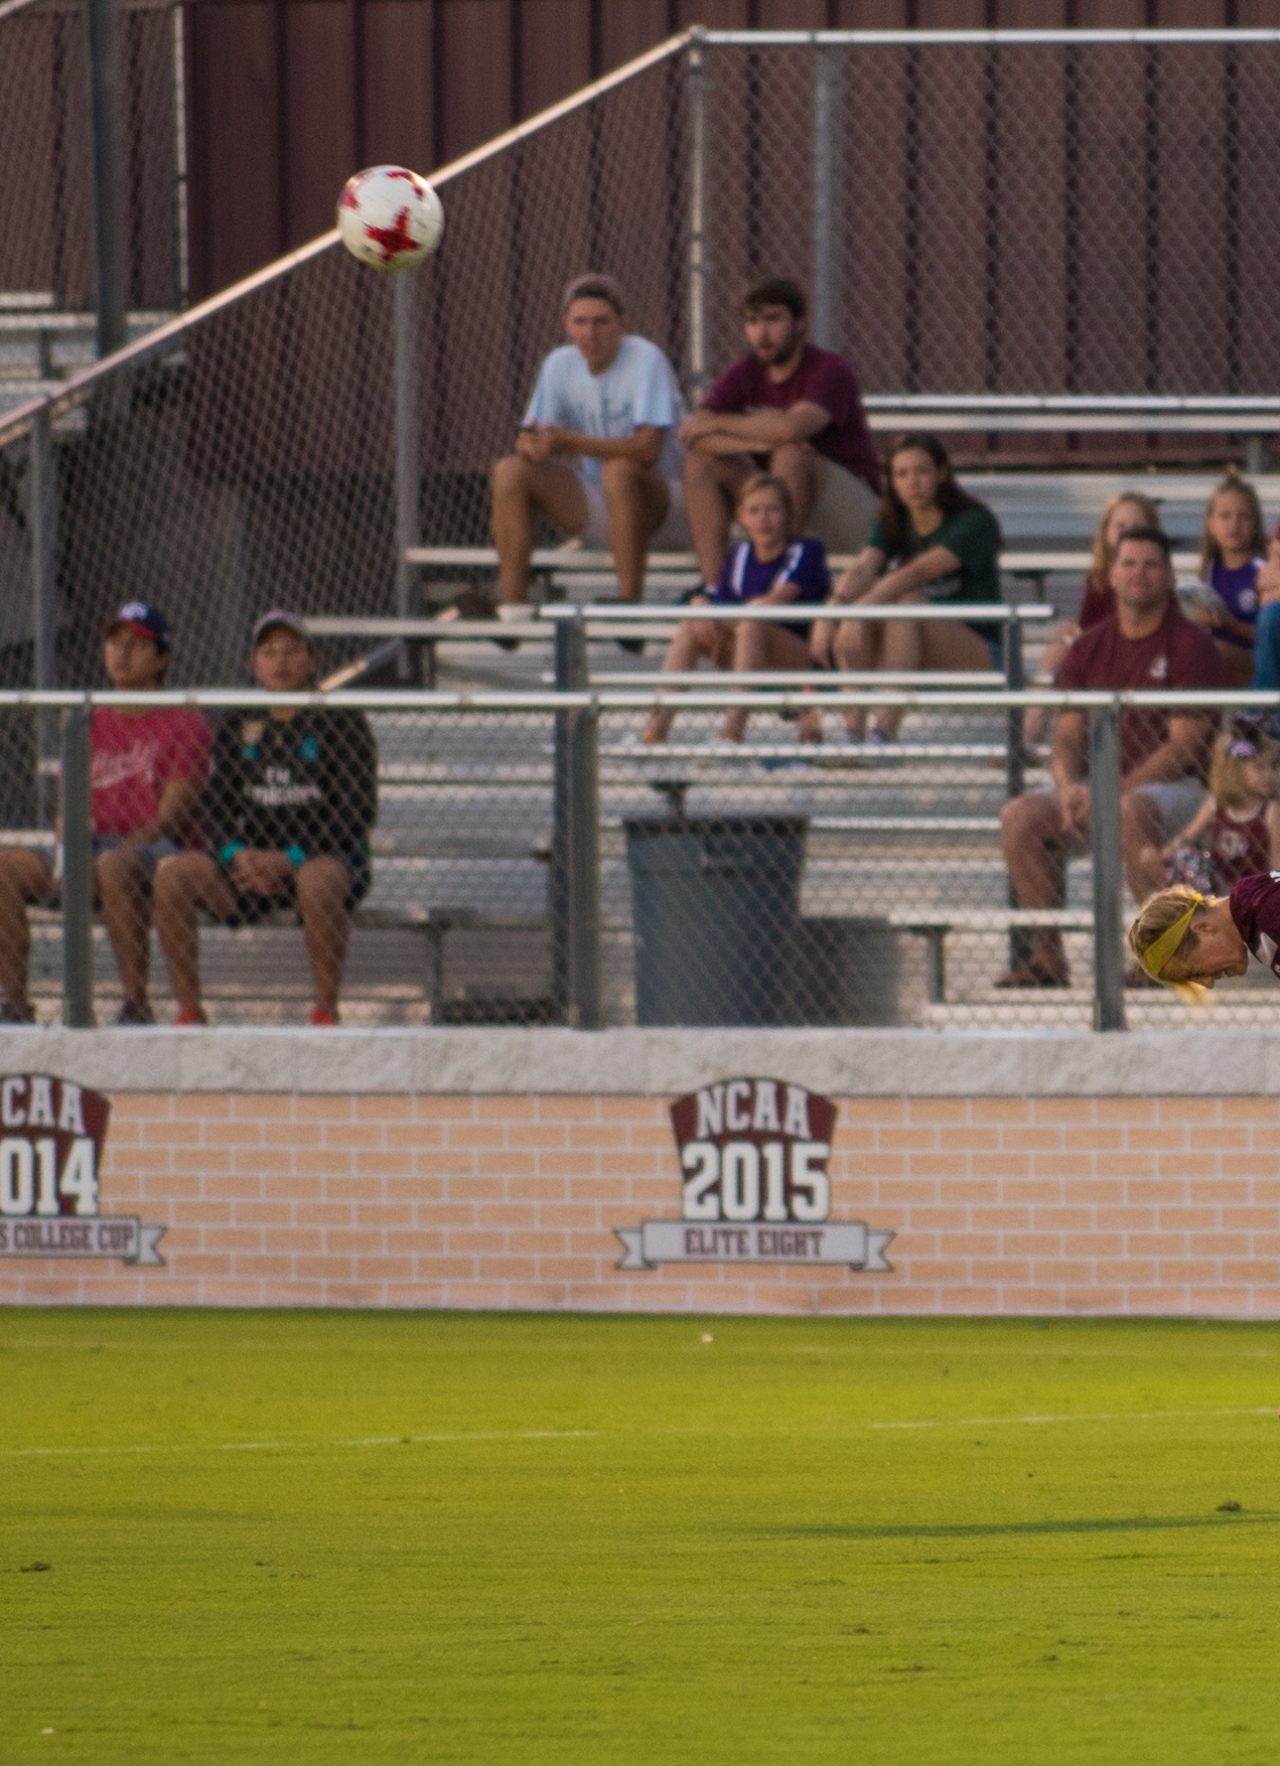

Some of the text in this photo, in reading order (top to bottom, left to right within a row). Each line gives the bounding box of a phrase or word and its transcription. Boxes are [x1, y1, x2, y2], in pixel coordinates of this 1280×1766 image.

[2, 1075, 87, 1136] CAA
[697, 1079, 812, 1139] NCAA
[0, 1136, 99, 1216] 014
[682, 1141, 831, 1222] 2015
[14, 1223, 93, 1251] COLLEGE
[97, 1224, 134, 1251] CUP
[684, 1228, 825, 1257] ELITE EIGHT
